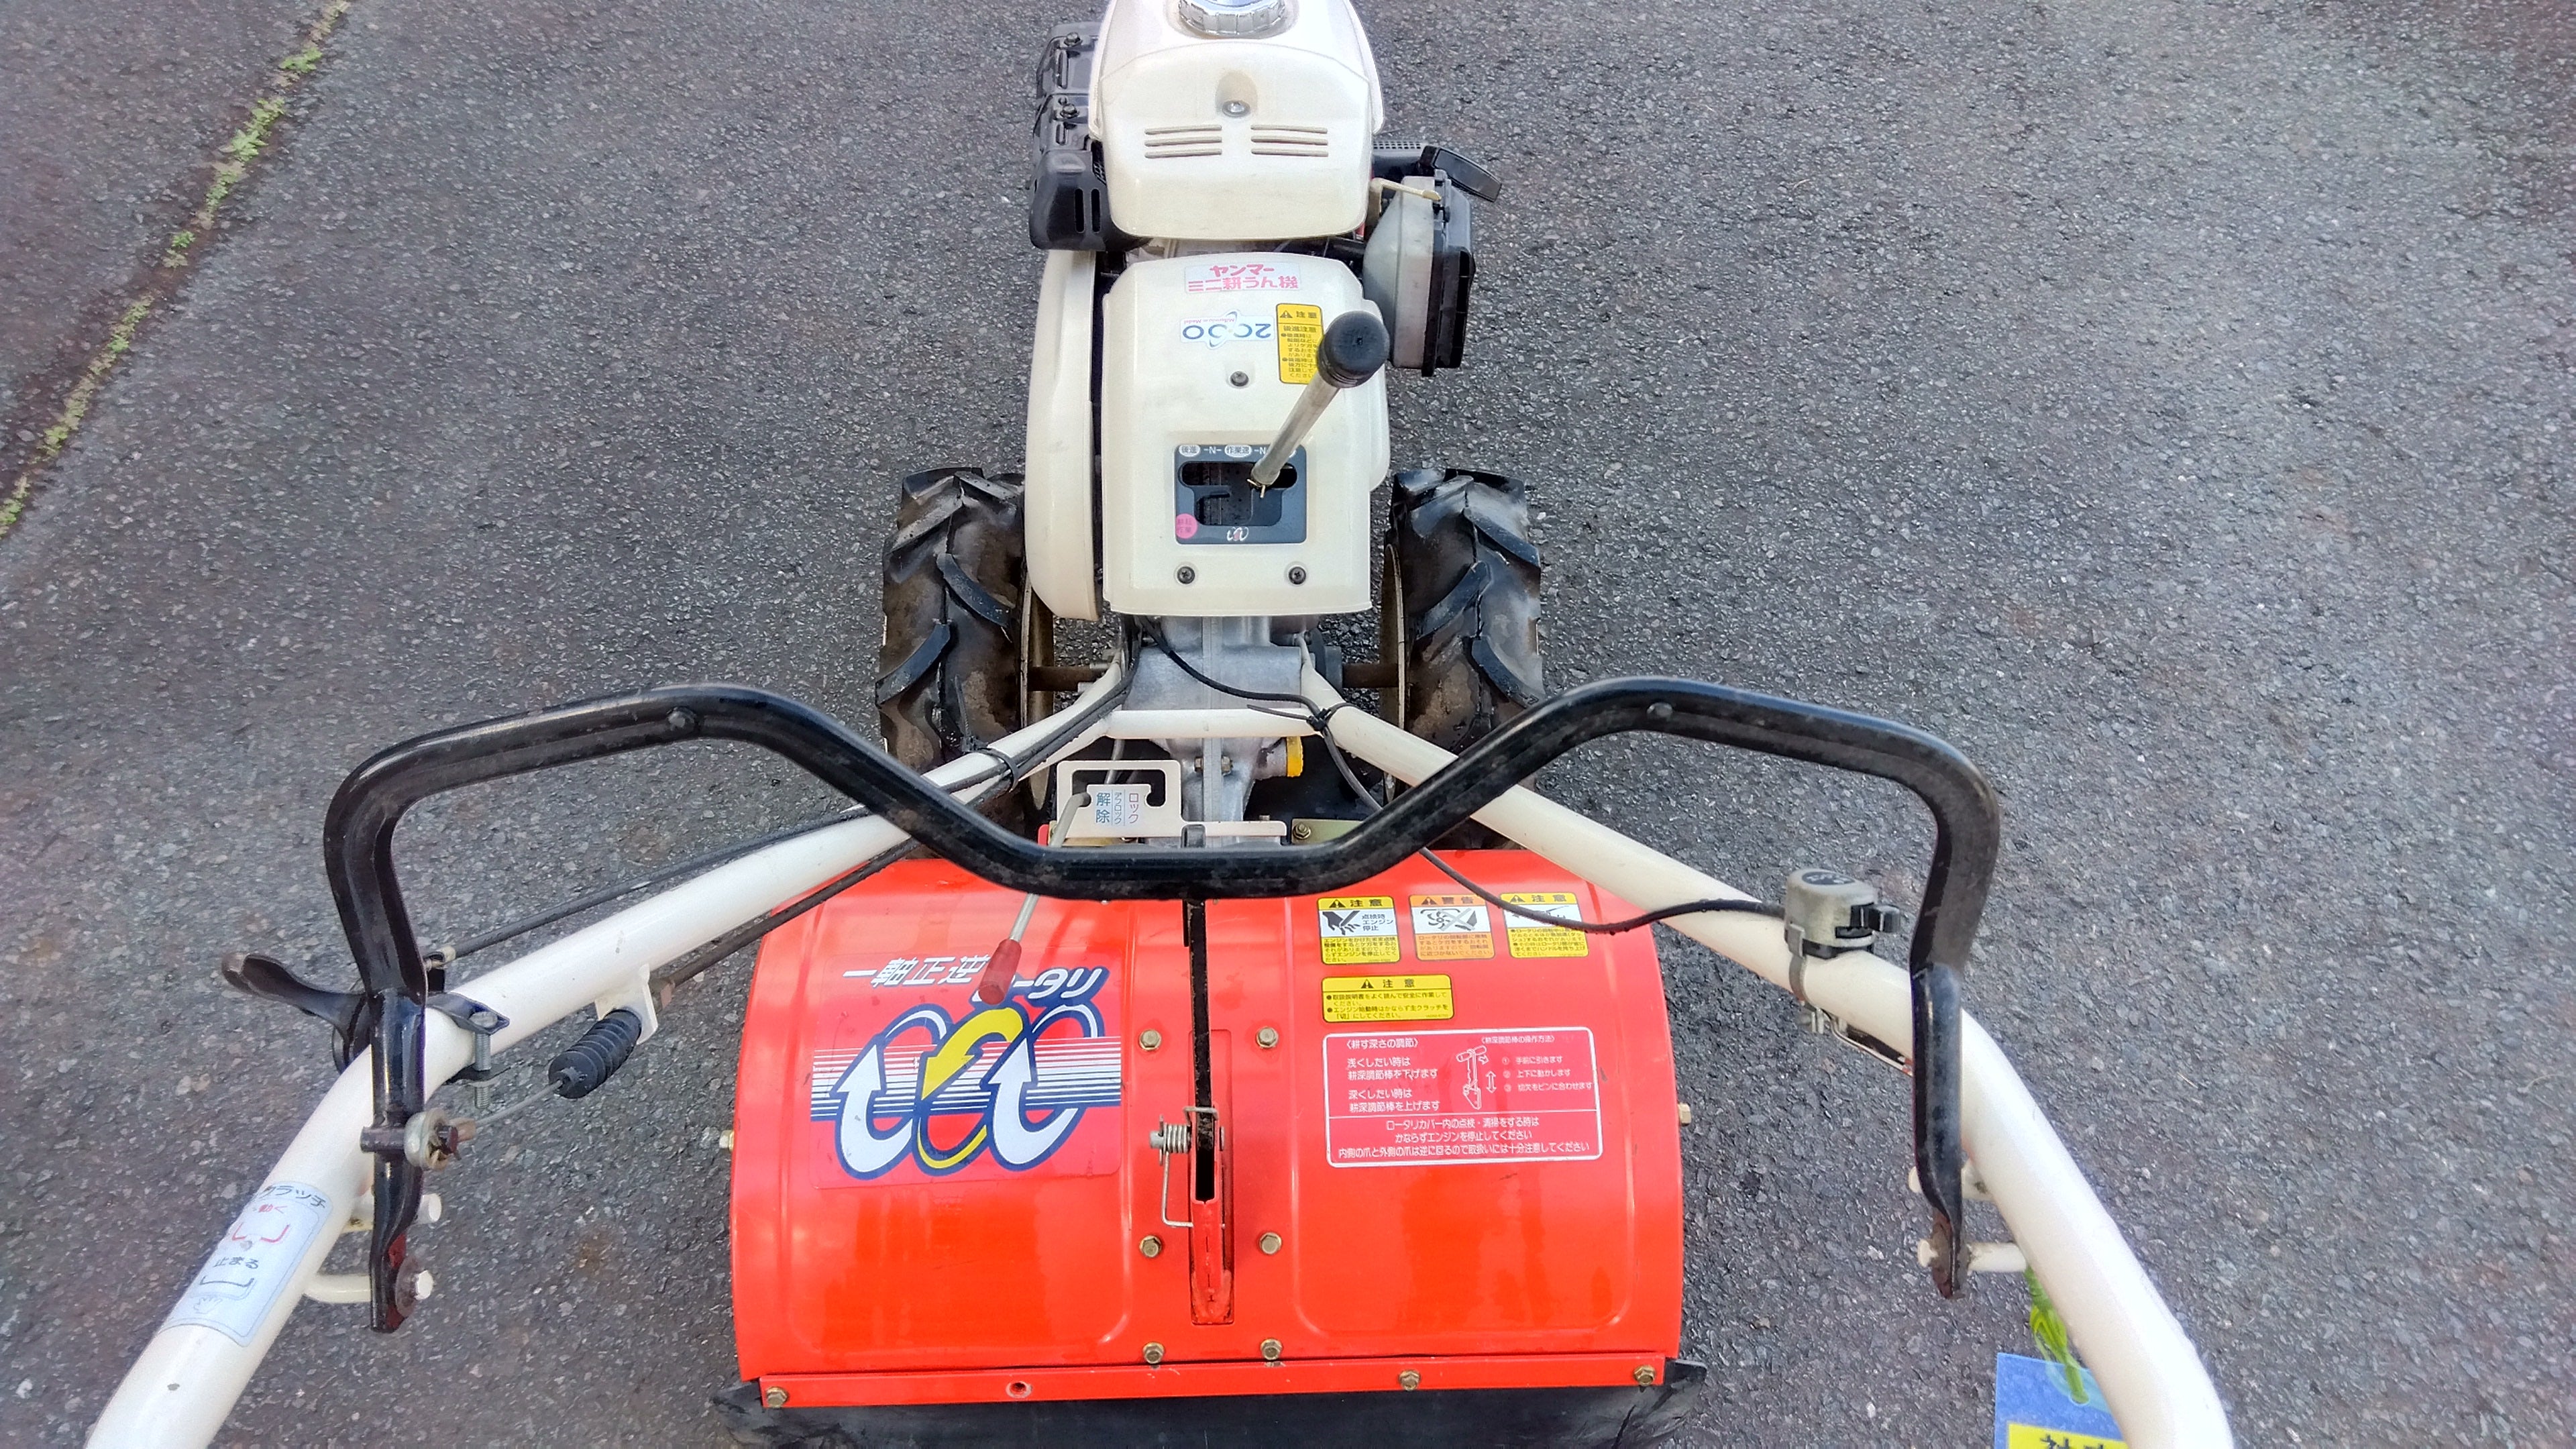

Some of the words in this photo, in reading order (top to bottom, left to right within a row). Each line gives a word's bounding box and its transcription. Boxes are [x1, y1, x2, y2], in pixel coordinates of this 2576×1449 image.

[1210, 264, 1275, 277] ヤンマー
[1188, 276, 1299, 292] ミニ耕うん機
[1296, 311, 1317, 319] 注意
[1095, 792, 1111, 823] 解除
[1128, 793, 1139, 824] ロック
[1350, 899, 1383, 907] 注意
[1442, 896, 1474, 904] 警告
[843, 954, 991, 988] 一軸正逆
[1383, 979, 1415, 988] 注意
[1347, 1057, 1411, 1068] 浅くしたい時は
[1515, 1056, 1563, 1065] 手前に引きます
[1348, 1069, 1438, 1081] 耕深調節棒を下げます
[1517, 1069, 1571, 1079] 上下に動かします
[1348, 1088, 1412, 1100] 深くしたい時は
[1349, 1100, 1440, 1113] 耕深調節棒を上げます
[1395, 1130, 1532, 1144] かならずエンジンを停止してください
[257, 1185, 327, 1208] クラッチ
[213, 1256, 258, 1269] 止まる
